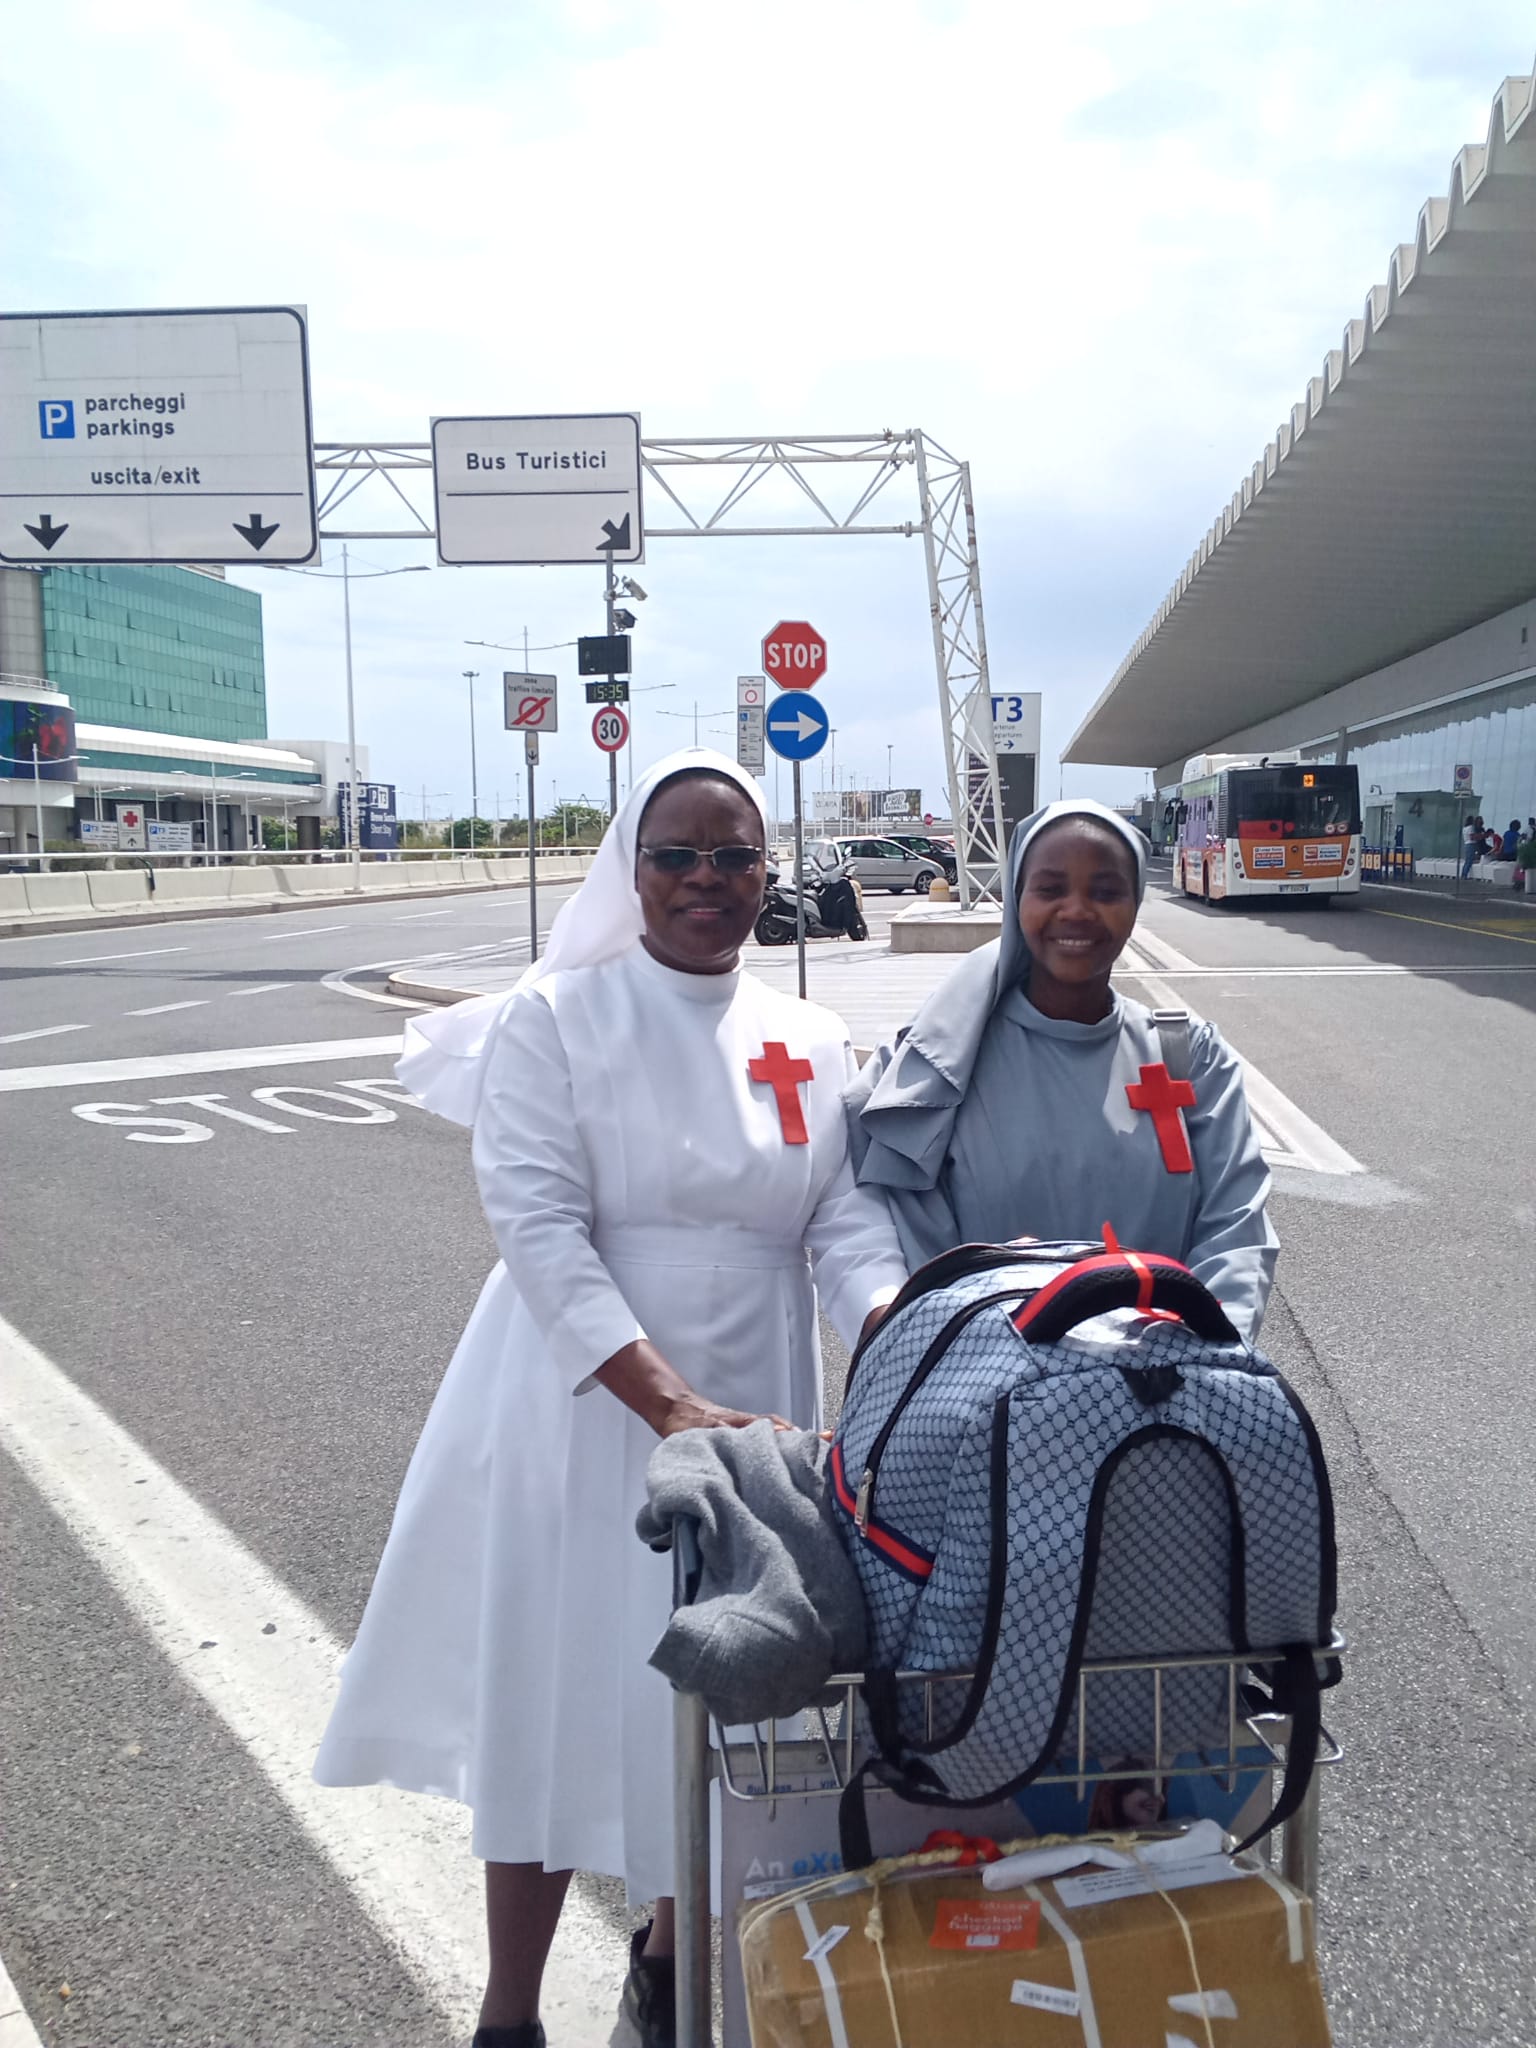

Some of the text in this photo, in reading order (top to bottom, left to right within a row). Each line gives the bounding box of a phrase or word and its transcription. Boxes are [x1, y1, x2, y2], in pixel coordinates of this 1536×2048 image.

[85, 393, 185, 414] parcheggi
[44, 403, 68, 436] P
[87, 419, 175, 439] parkings
[466, 451, 608, 471] Bus Turistici
[91, 466, 200, 485] uscita/exit
[767, 642, 823, 669] STOP
[593, 684, 624, 700] 15:35
[990, 696, 1023, 722] T3
[600, 718, 620, 740] 30
[1408, 797, 1424, 818] 4
[744, 1852, 841, 1879] An eXt
